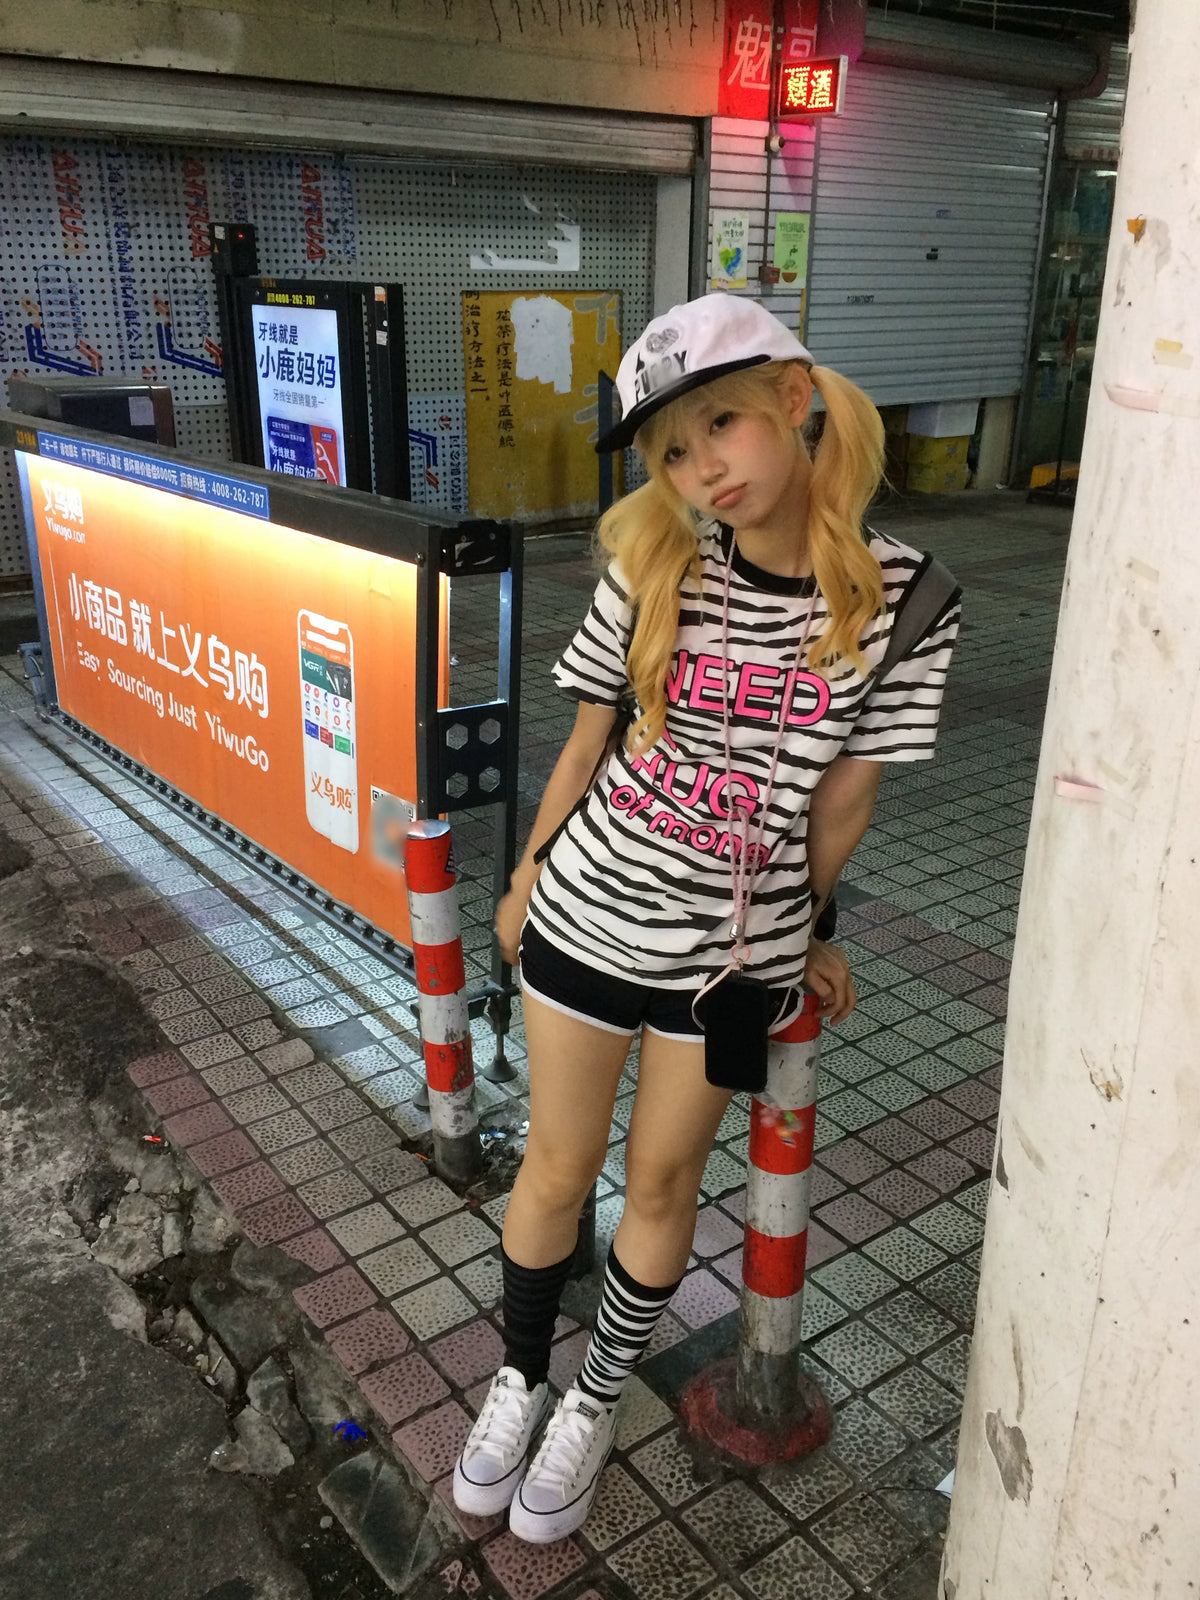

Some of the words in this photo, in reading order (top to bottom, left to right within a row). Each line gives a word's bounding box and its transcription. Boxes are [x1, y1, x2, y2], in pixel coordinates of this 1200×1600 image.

[258, 322, 299, 346] 牙线就是
[259, 345, 336, 388] 小鹿妈妈
[40, 478, 85, 525] 义乌购
[107, 658, 165, 718] Sourcing
[168, 691, 198, 731] Just
[204, 711, 270, 772] YiwuGo
[310, 770, 353, 814] 义乌购
[609, 785, 656, 819] of
